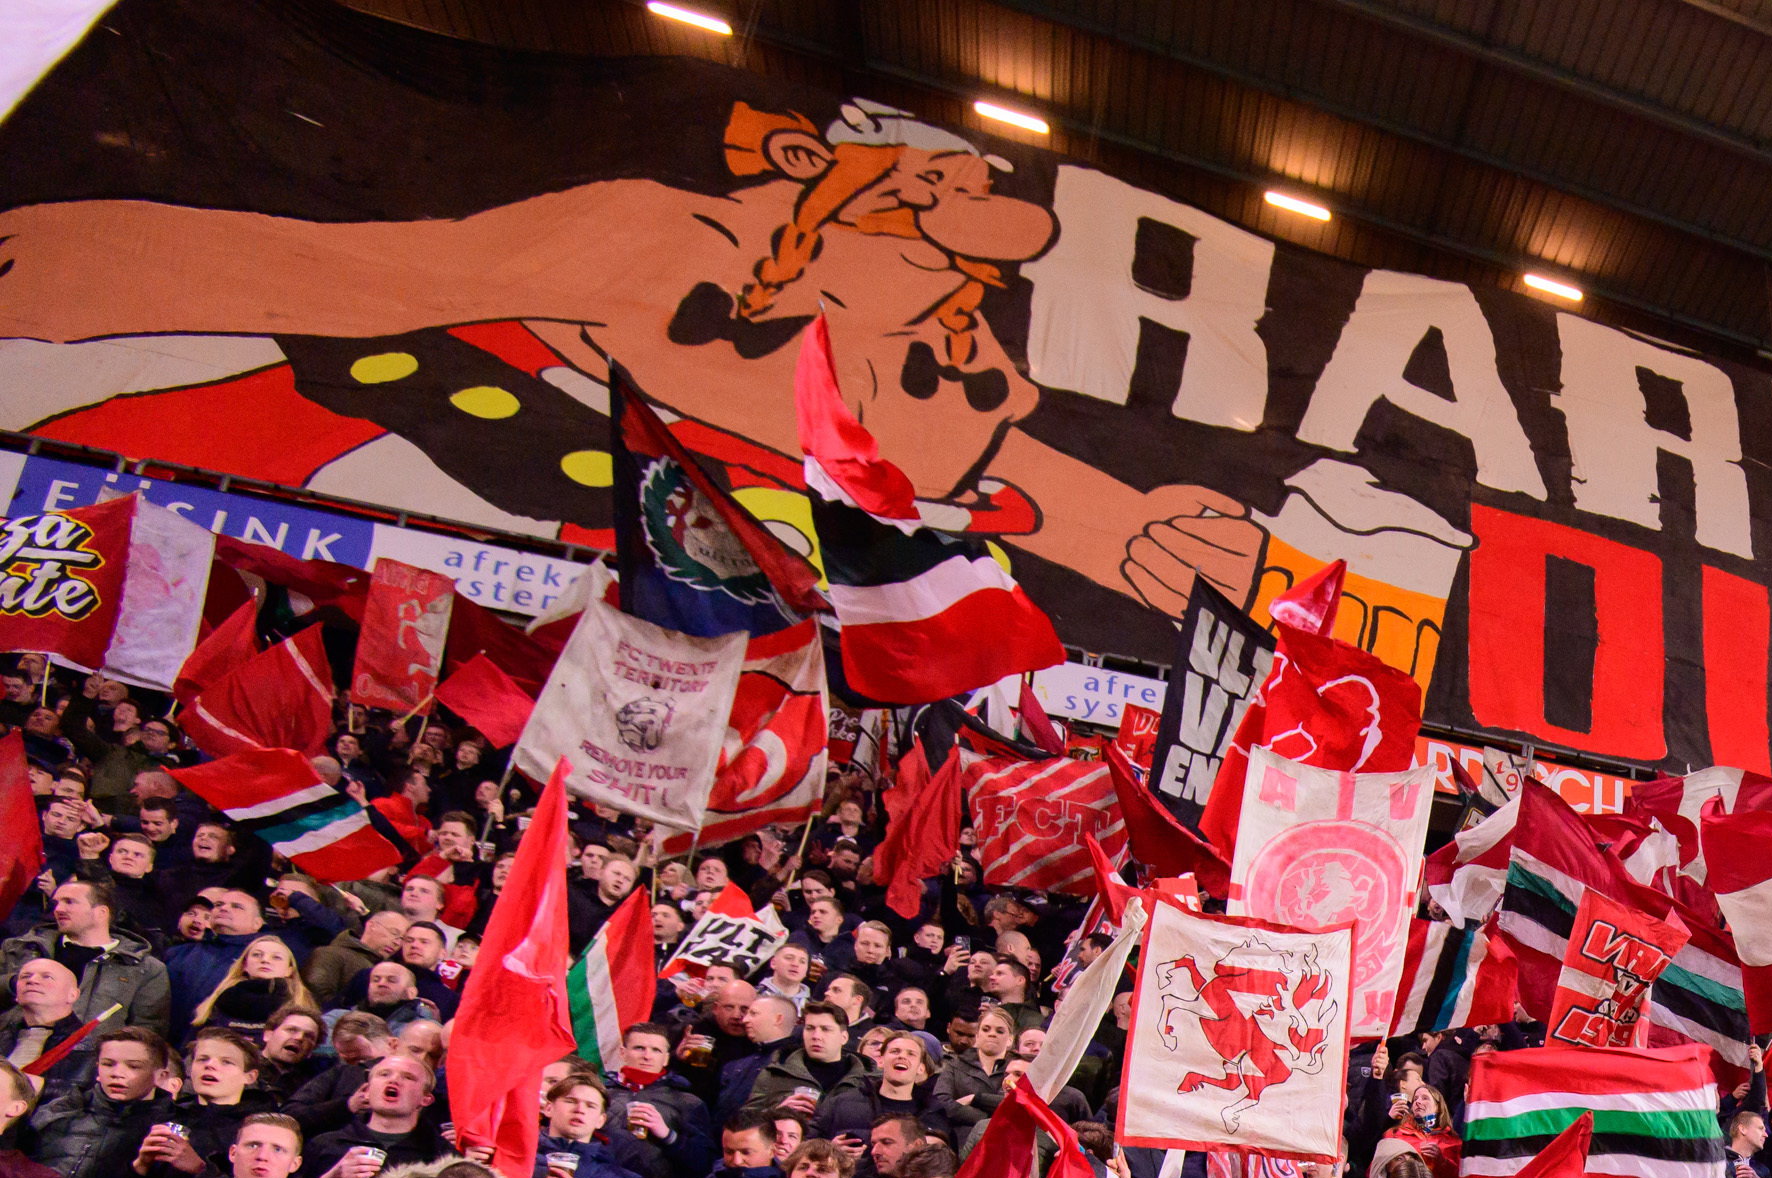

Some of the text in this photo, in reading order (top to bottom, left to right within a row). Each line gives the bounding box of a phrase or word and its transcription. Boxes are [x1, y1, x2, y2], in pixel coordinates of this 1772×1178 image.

[443, 549, 578, 588] afrek
[453, 577, 560, 610] ster
[578, 739, 688, 780] REMOVE YOUR
